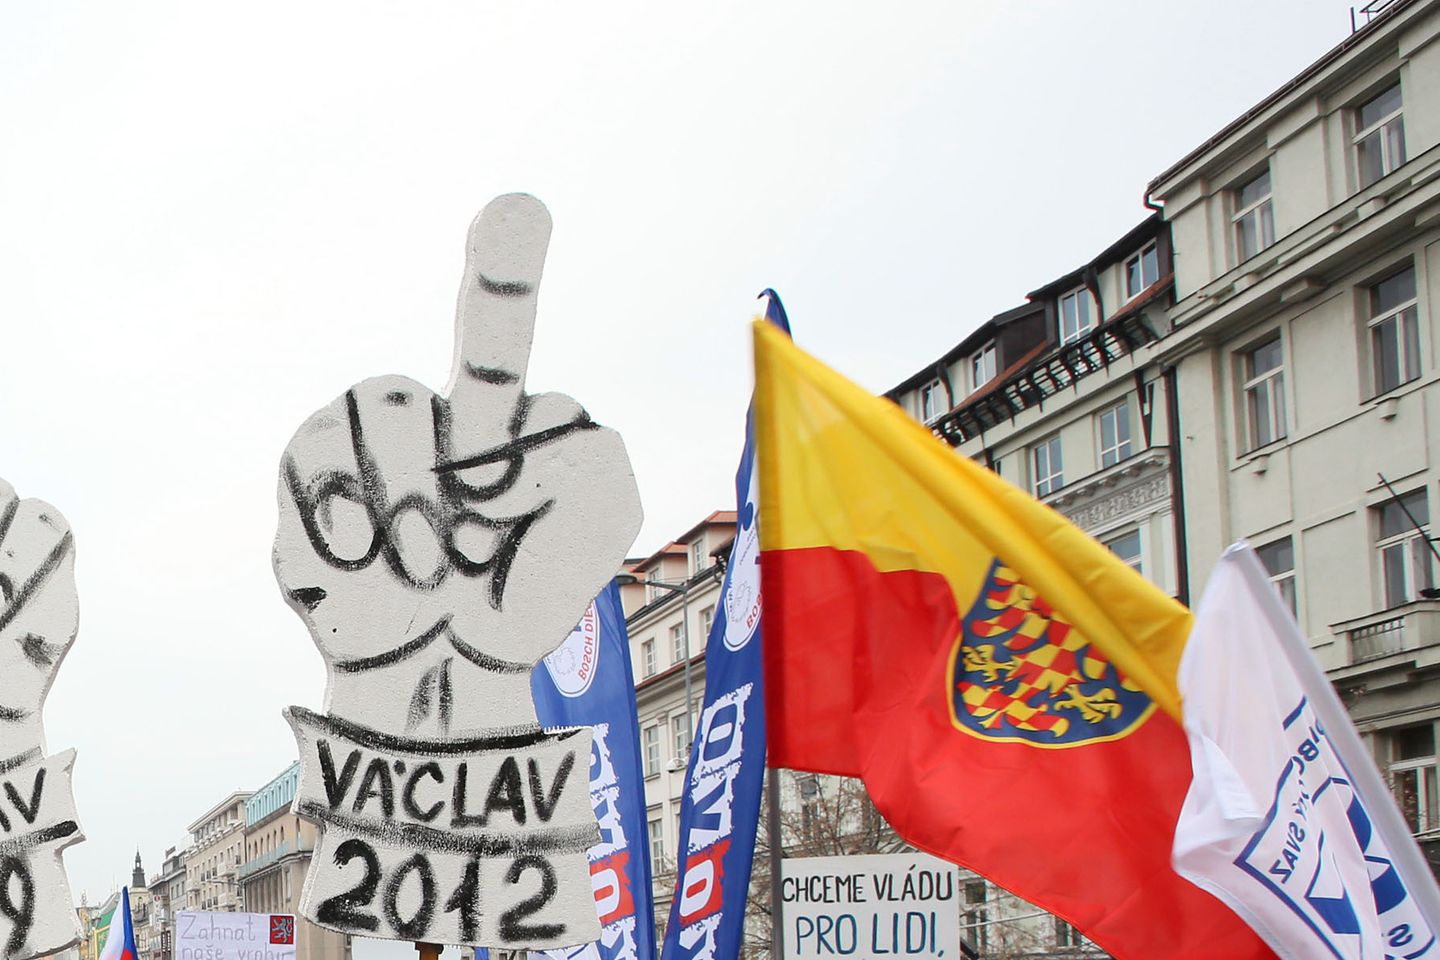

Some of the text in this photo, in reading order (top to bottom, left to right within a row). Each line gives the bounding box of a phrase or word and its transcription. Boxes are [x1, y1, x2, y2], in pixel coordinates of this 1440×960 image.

[316, 738, 576, 829] VÁCLAV
[315, 838, 568, 942] 2012
[782, 864, 953, 903] CHCEME VLÁDU
[180, 914, 256, 941] Zahnat
[796, 911, 945, 958] PRO LIDI,
[181, 944, 225, 960] naše
